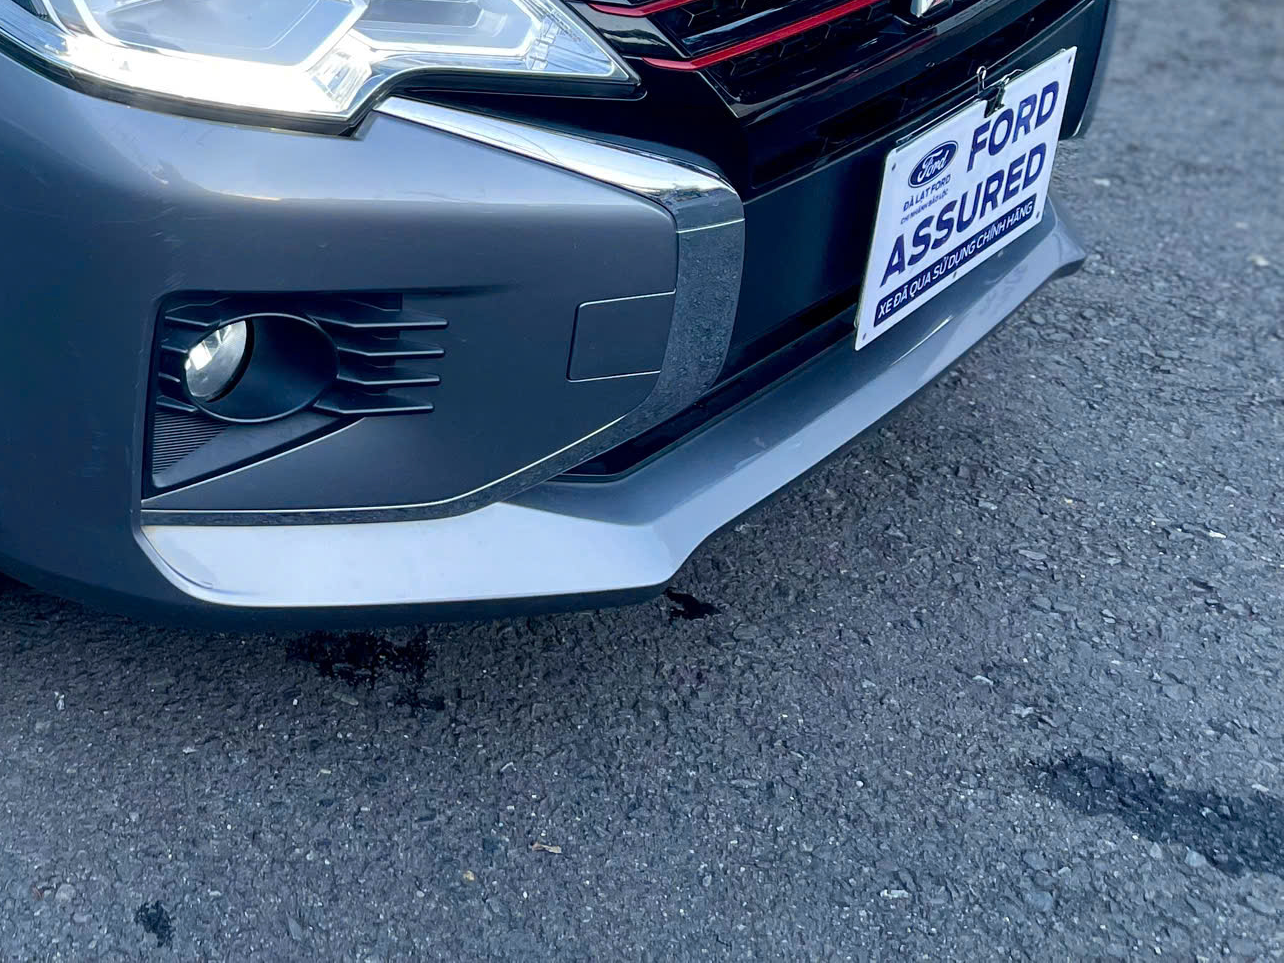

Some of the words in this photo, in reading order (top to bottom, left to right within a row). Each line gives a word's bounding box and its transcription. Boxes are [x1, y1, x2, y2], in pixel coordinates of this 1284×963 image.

[967, 80, 1060, 174] FORD
[879, 141, 1047, 288] ASSURED
[930, 174, 952, 194] FORD
[877, 298, 893, 318] XE
[893, 285, 908, 307] ĐÃ
[909, 273, 931, 297] QUA
[932, 256, 949, 280] SỬ
[947, 243, 976, 269] DỤNG
[976, 221, 1006, 248] CHÍNH
[1006, 201, 1034, 228] HÃNG
